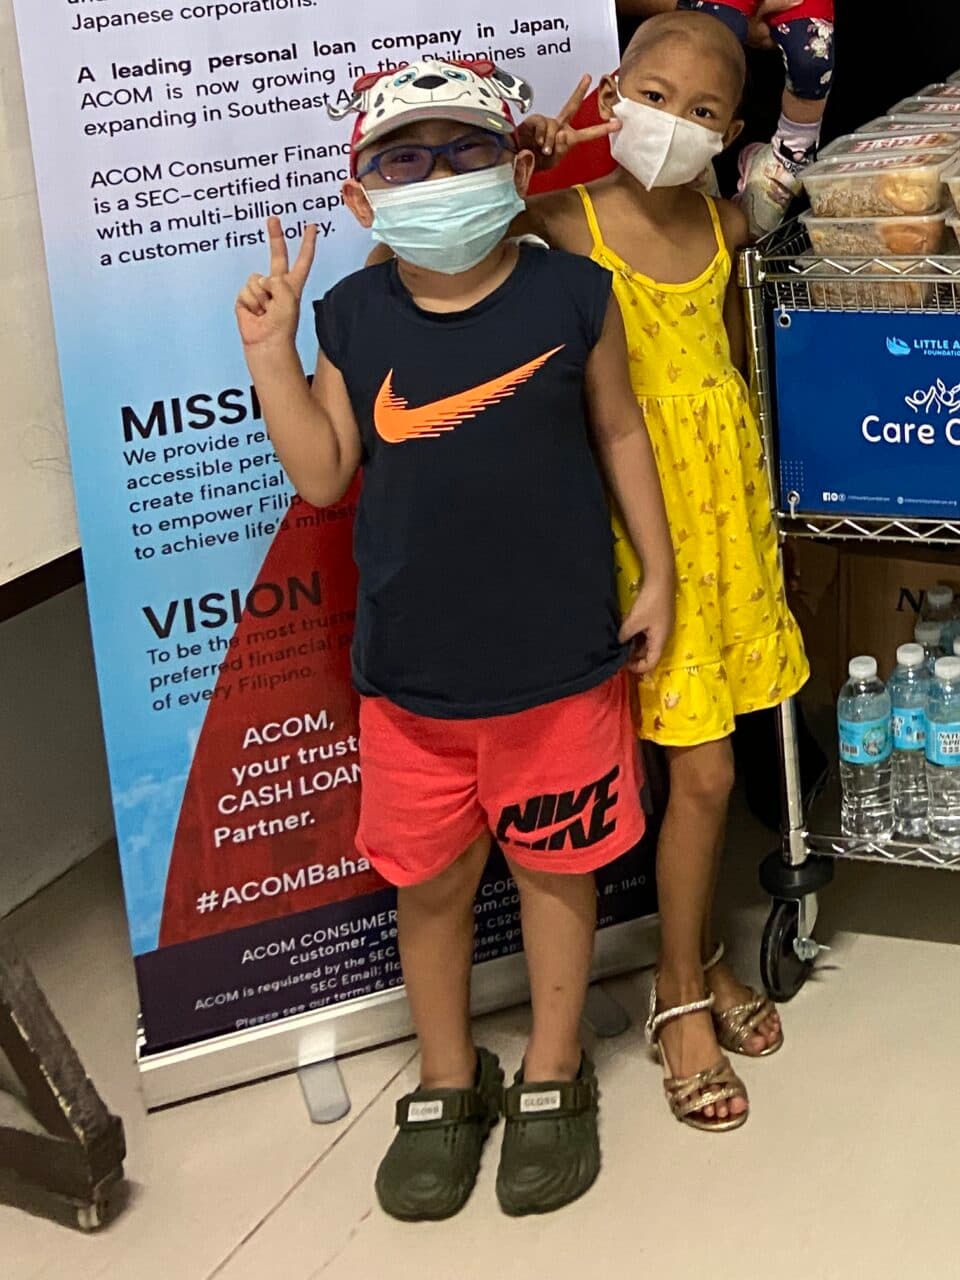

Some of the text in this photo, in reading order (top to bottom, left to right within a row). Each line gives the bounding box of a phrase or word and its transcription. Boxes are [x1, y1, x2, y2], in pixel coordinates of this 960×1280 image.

[72, 9, 173, 32] Japanese
[78, 17, 568, 84] A leading personal loan company in Japan,
[81, 85, 152, 110] ACOM
[166, 83, 183, 100] is
[196, 79, 239, 97] now
[253, 67, 335, 94] growing
[347, 61, 366, 79] in
[537, 37, 571, 55] and
[84, 109, 196, 138] expanding
[203, 105, 221, 122] in
[228, 92, 329, 119] Southeast
[91, 143, 351, 189] ACOM Consumer Financ
[94, 168, 347, 215] is a SEC-certified financ
[97, 185, 344, 240] with a multi-billion capi
[101, 253, 111, 266] a
[119, 238, 219, 264] customer
[226, 227, 266, 249] first
[914, 339, 949, 349] LITTLE
[861, 415, 935, 445] Care
[123, 448, 156, 466] We
[163, 435, 239, 462] provide
[127, 452, 280, 490] accessible pers
[130, 469, 285, 513] create financial
[132, 493, 303, 537] to empower Filip
[135, 546, 155, 560] to
[162, 530, 239, 555] achieve
[142, 570, 322, 640] VISION
[147, 648, 170, 664] To
[177, 643, 201, 659] be
[208, 634, 239, 652] the
[150, 657, 242, 692] preferred
[153, 665, 314, 711] of every Filipino.
[243, 710, 334, 749] ACOM,
[232, 735, 357, 785] your trust
[218, 780, 292, 815] CASH
[496, 764, 620, 851] NIKE
[214, 811, 315, 848] Partner.
[197, 855, 370, 914] #ACOMBaha
[242, 937, 295, 964] ACOM
[290, 928, 397, 965] customer_se
[195, 990, 238, 1011] ACOM
[243, 988, 254, 998] is
[325, 964, 340, 975] by
[345, 957, 364, 969] the
[369, 946, 394, 962] SEC
[311, 977, 336, 994] SEC
